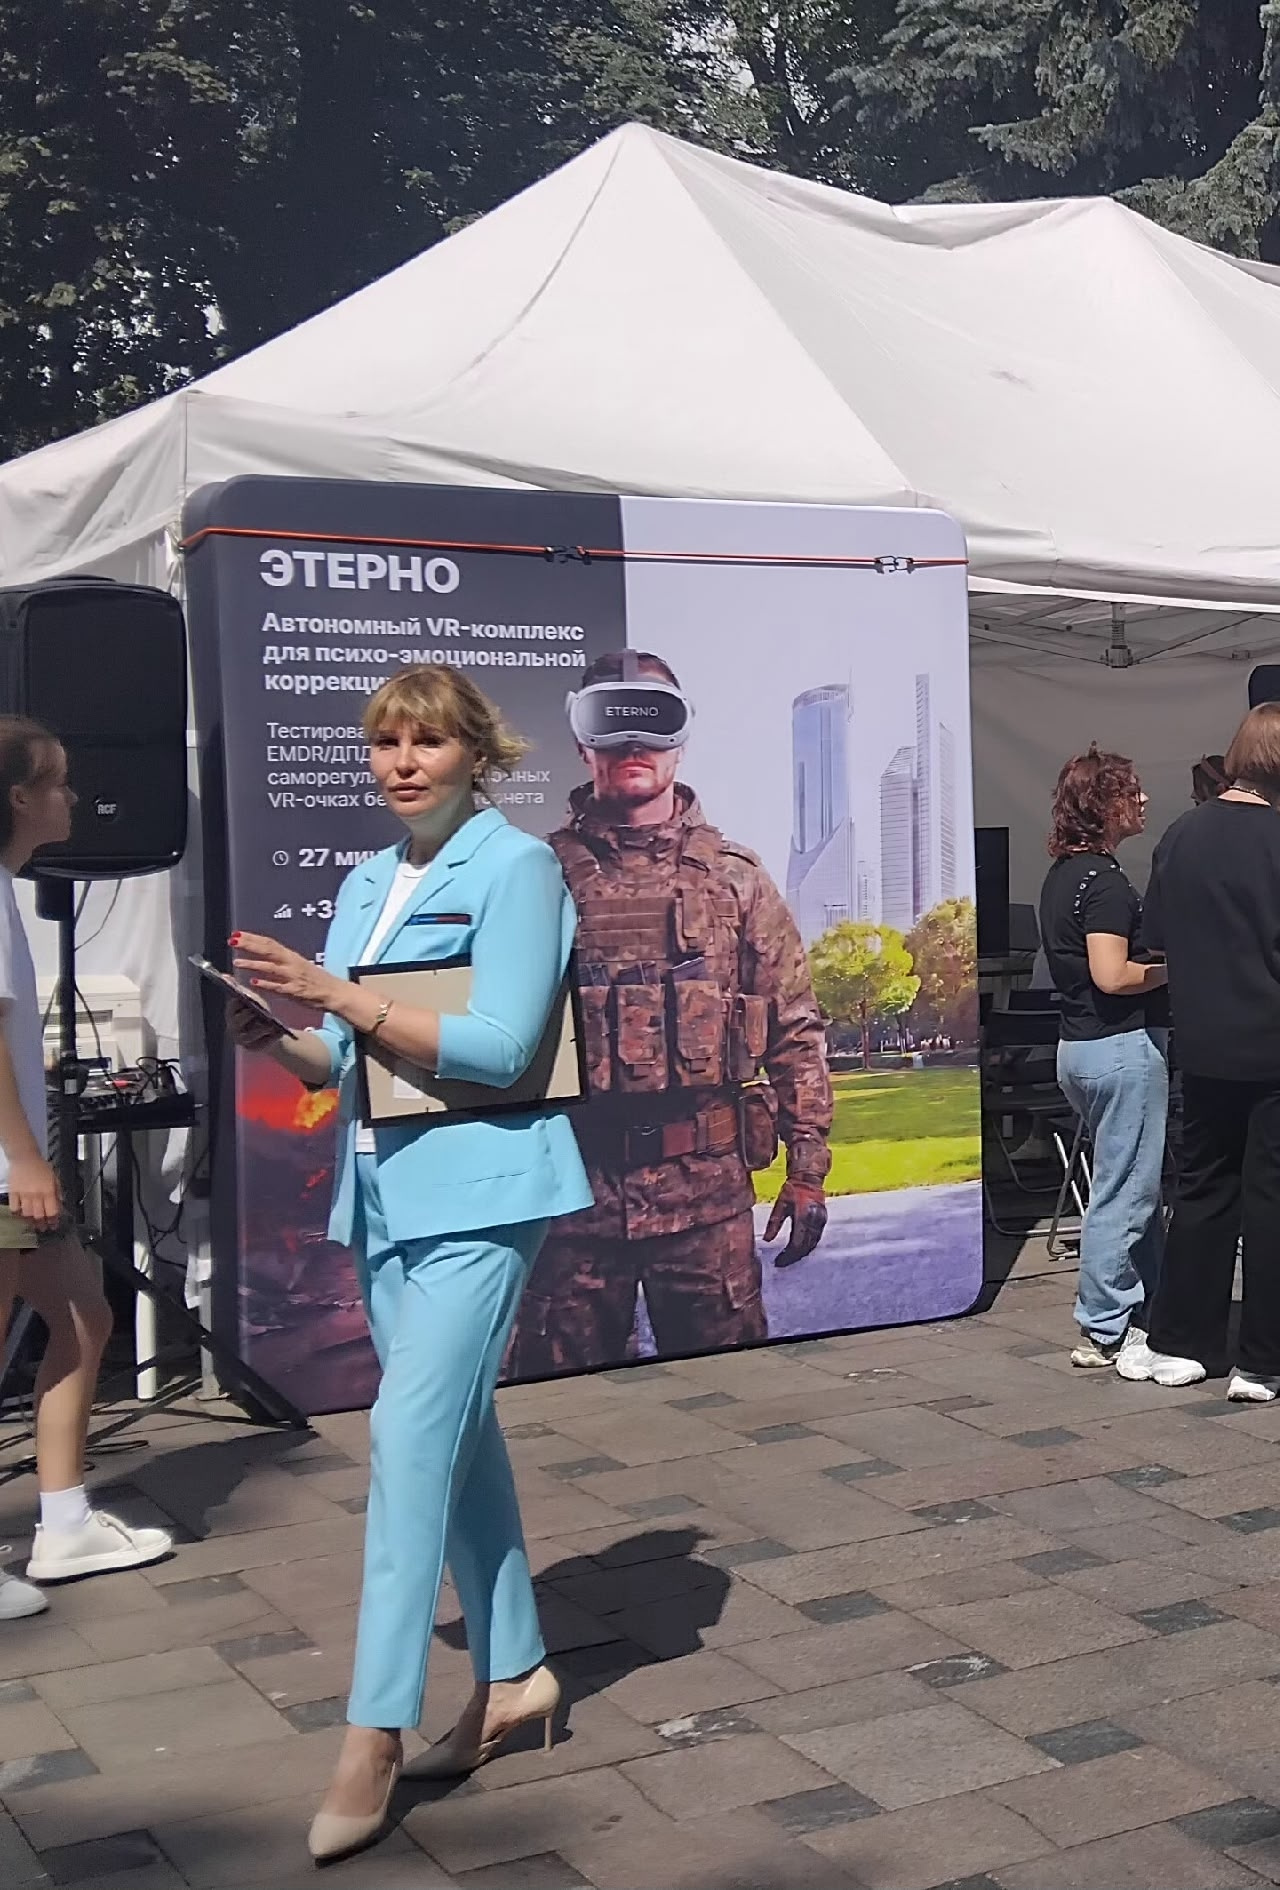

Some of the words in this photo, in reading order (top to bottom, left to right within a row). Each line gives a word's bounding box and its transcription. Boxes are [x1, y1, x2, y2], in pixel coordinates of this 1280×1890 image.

[259, 549, 460, 594] ЭТЕРНО
[261, 612, 422, 636] Автономный
[426, 617, 585, 641] VR-комплекс
[262, 645, 310, 665] для
[315, 646, 587, 669] психо-эмоциональной
[264, 674, 391, 695] коррекци
[605, 706, 659, 717] ETERNO
[97, 803, 117, 815] RCF
[268, 792, 360, 808] VR-очках
[364, 791, 388, 807] бе
[298, 847, 332, 867] 27
[335, 850, 378, 866] ми
[301, 899, 337, 919] +3
